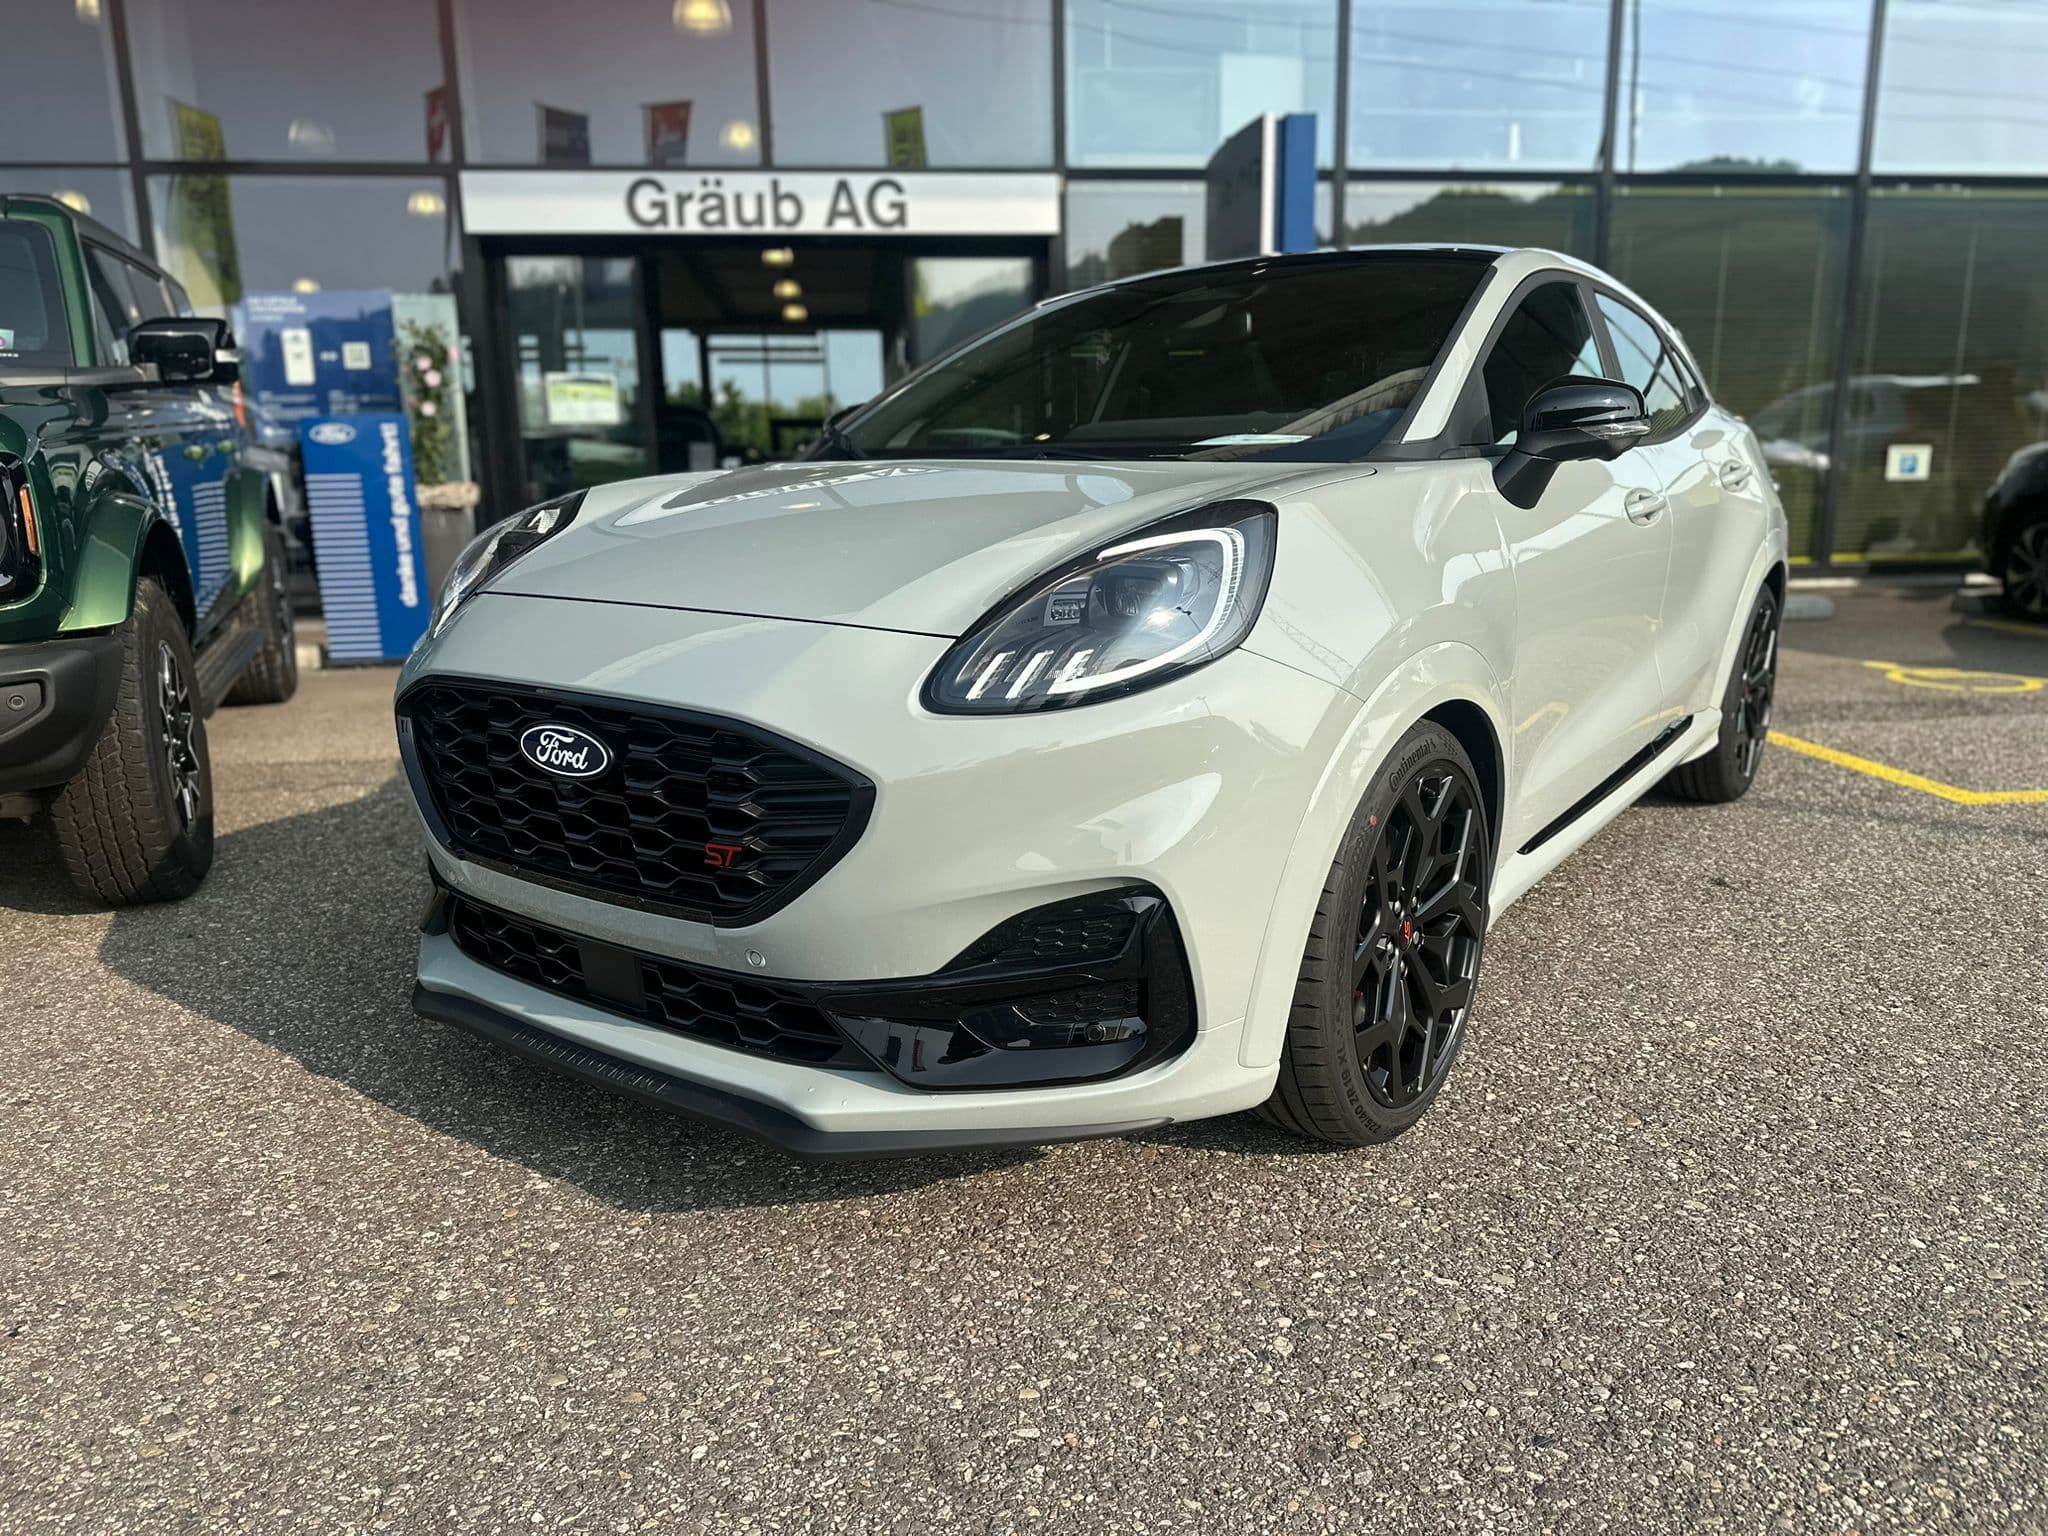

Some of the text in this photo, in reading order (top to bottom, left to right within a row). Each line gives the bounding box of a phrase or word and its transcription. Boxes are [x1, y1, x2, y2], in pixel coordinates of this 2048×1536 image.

[625, 177, 907, 229] Gräub AG
[536, 731, 588, 770] Ford
[1388, 739, 1432, 793] Continental
[704, 843, 742, 868] ST
